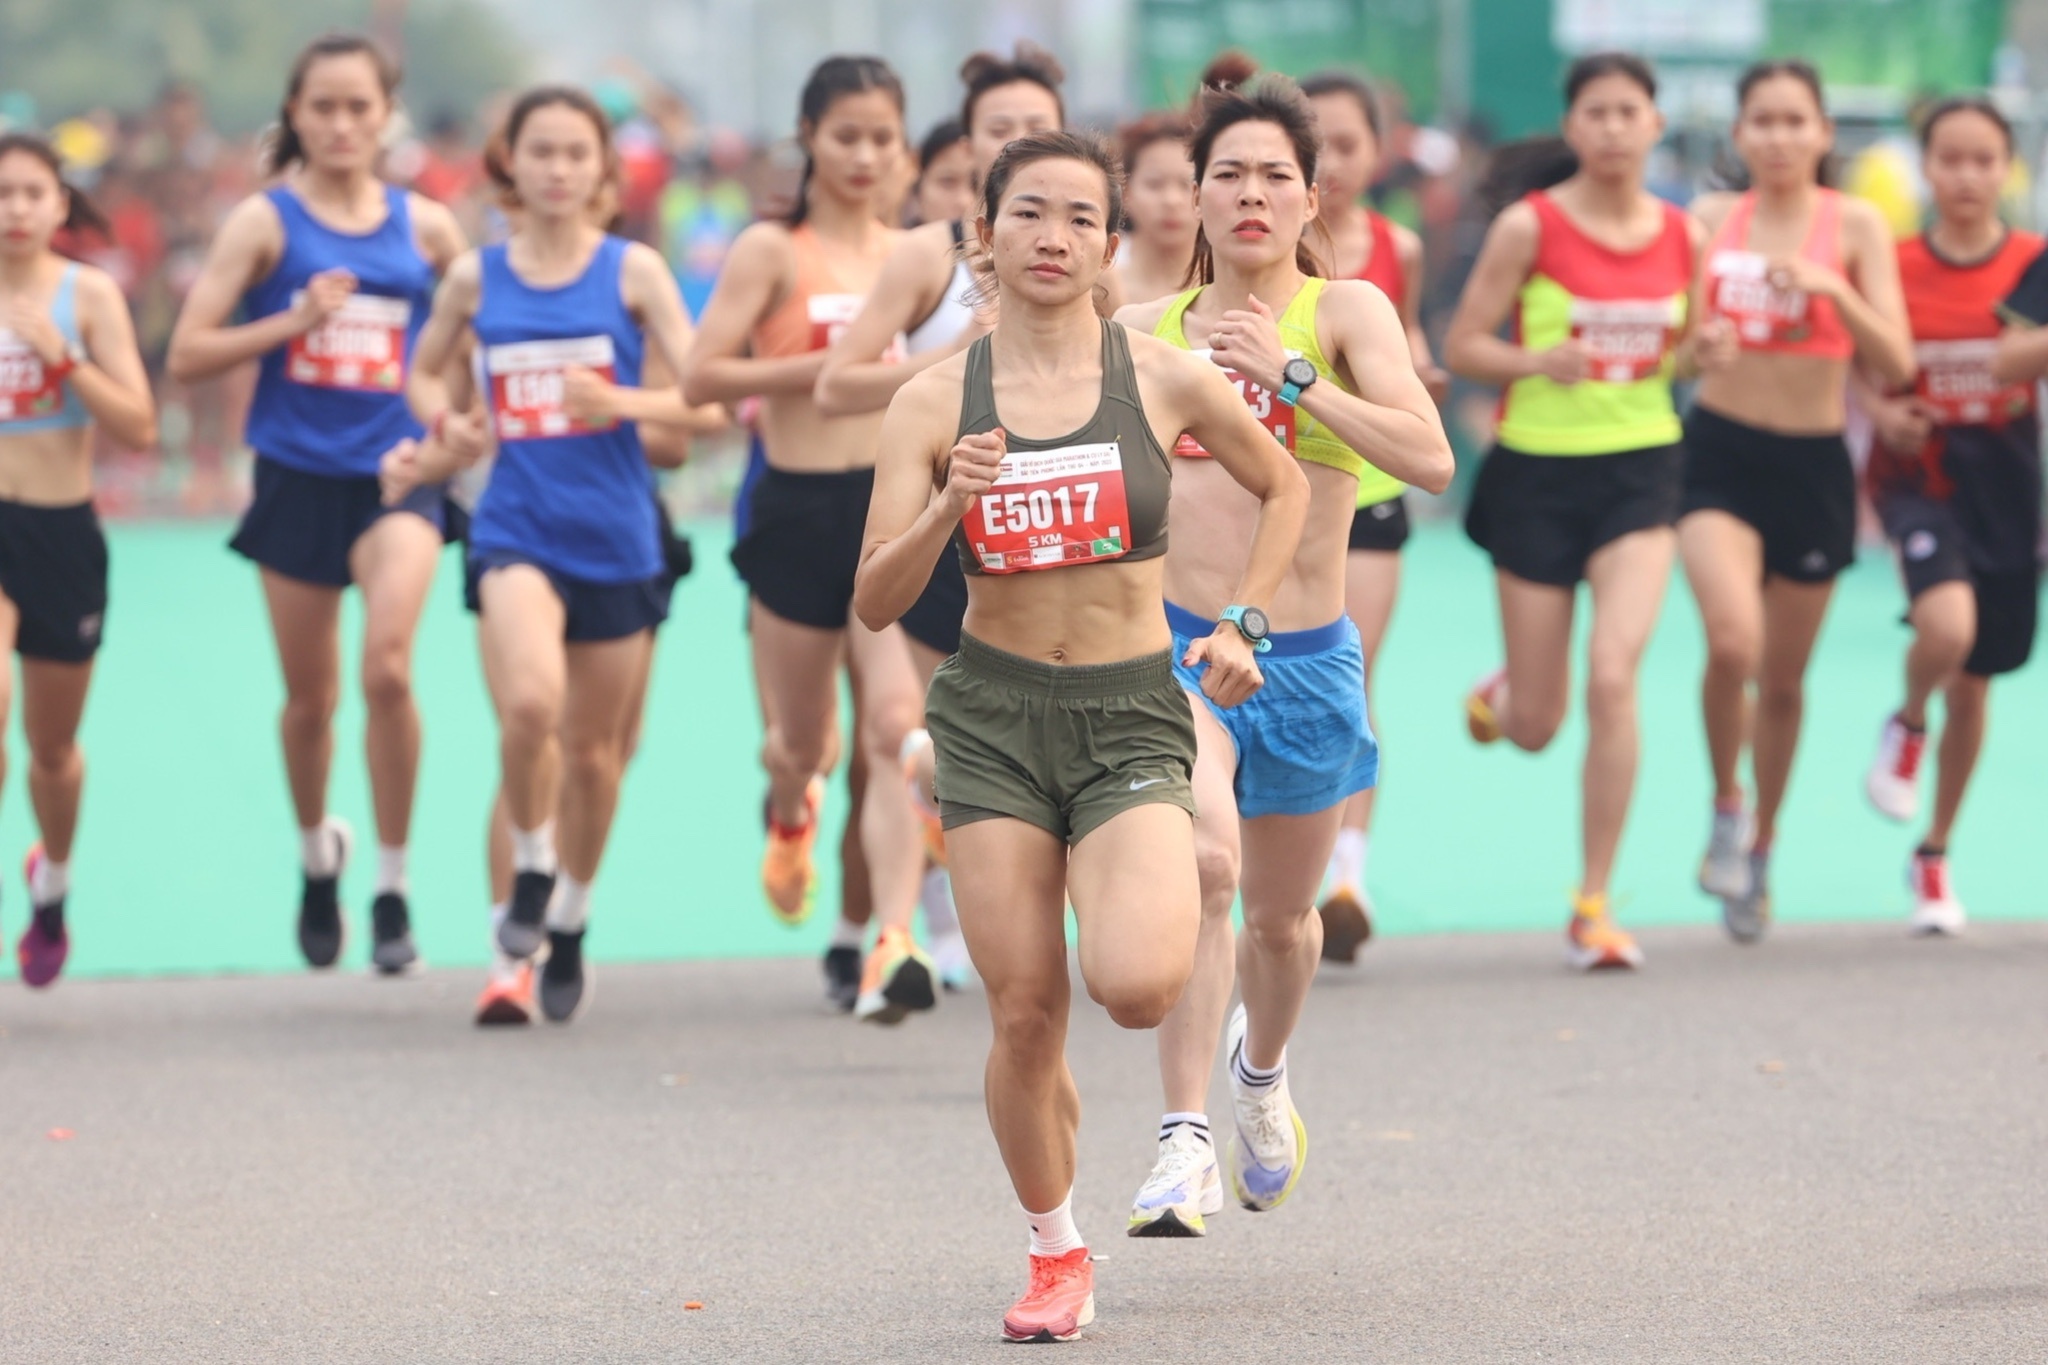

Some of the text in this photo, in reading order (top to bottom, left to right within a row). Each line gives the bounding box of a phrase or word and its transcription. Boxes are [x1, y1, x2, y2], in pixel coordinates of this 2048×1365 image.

[981, 482, 1099, 535] E5017
[1028, 532, 1063, 547] 5 KM
